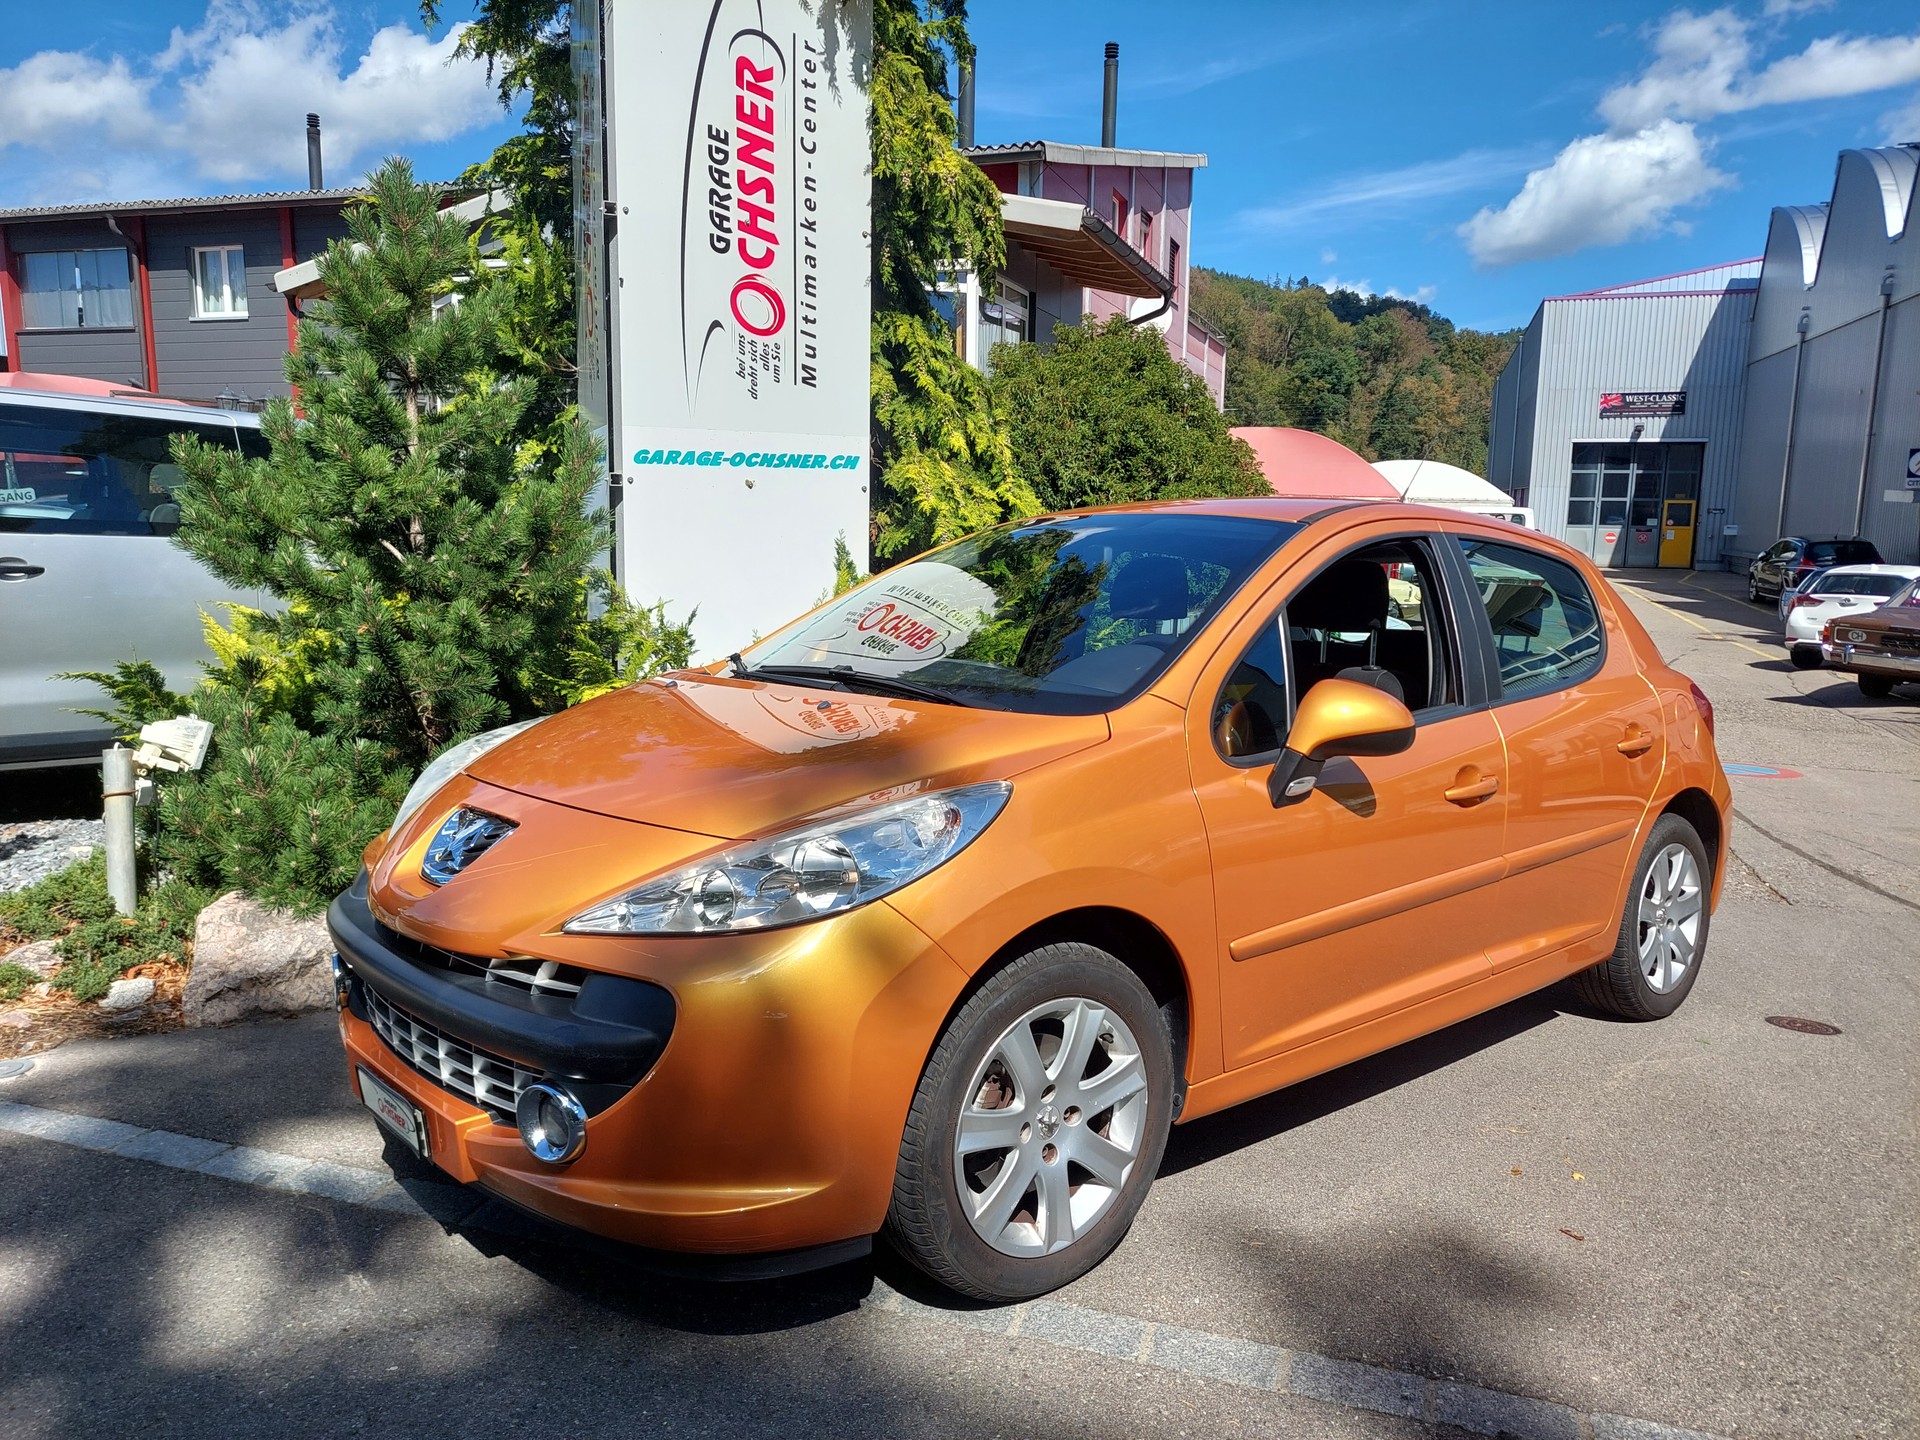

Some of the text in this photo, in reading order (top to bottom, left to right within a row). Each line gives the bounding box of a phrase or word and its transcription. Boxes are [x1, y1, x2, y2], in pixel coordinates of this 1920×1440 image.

[707, 124, 731, 254] GARAGE
[730, 55, 786, 337] OCHSNER
[800, 40, 818, 388] Multimarken-Center
[735, 333, 746, 379] bei uns
[747, 340, 758, 400] dreht sich
[759, 342, 770, 371] alles
[771, 342, 781, 383] um Sie
[1625, 394, 1686, 402] WEST-CLASSIC
[633, 449, 861, 470] GARAGE-OCHSNER.CH
[1851, 631, 1863, 640] CH
